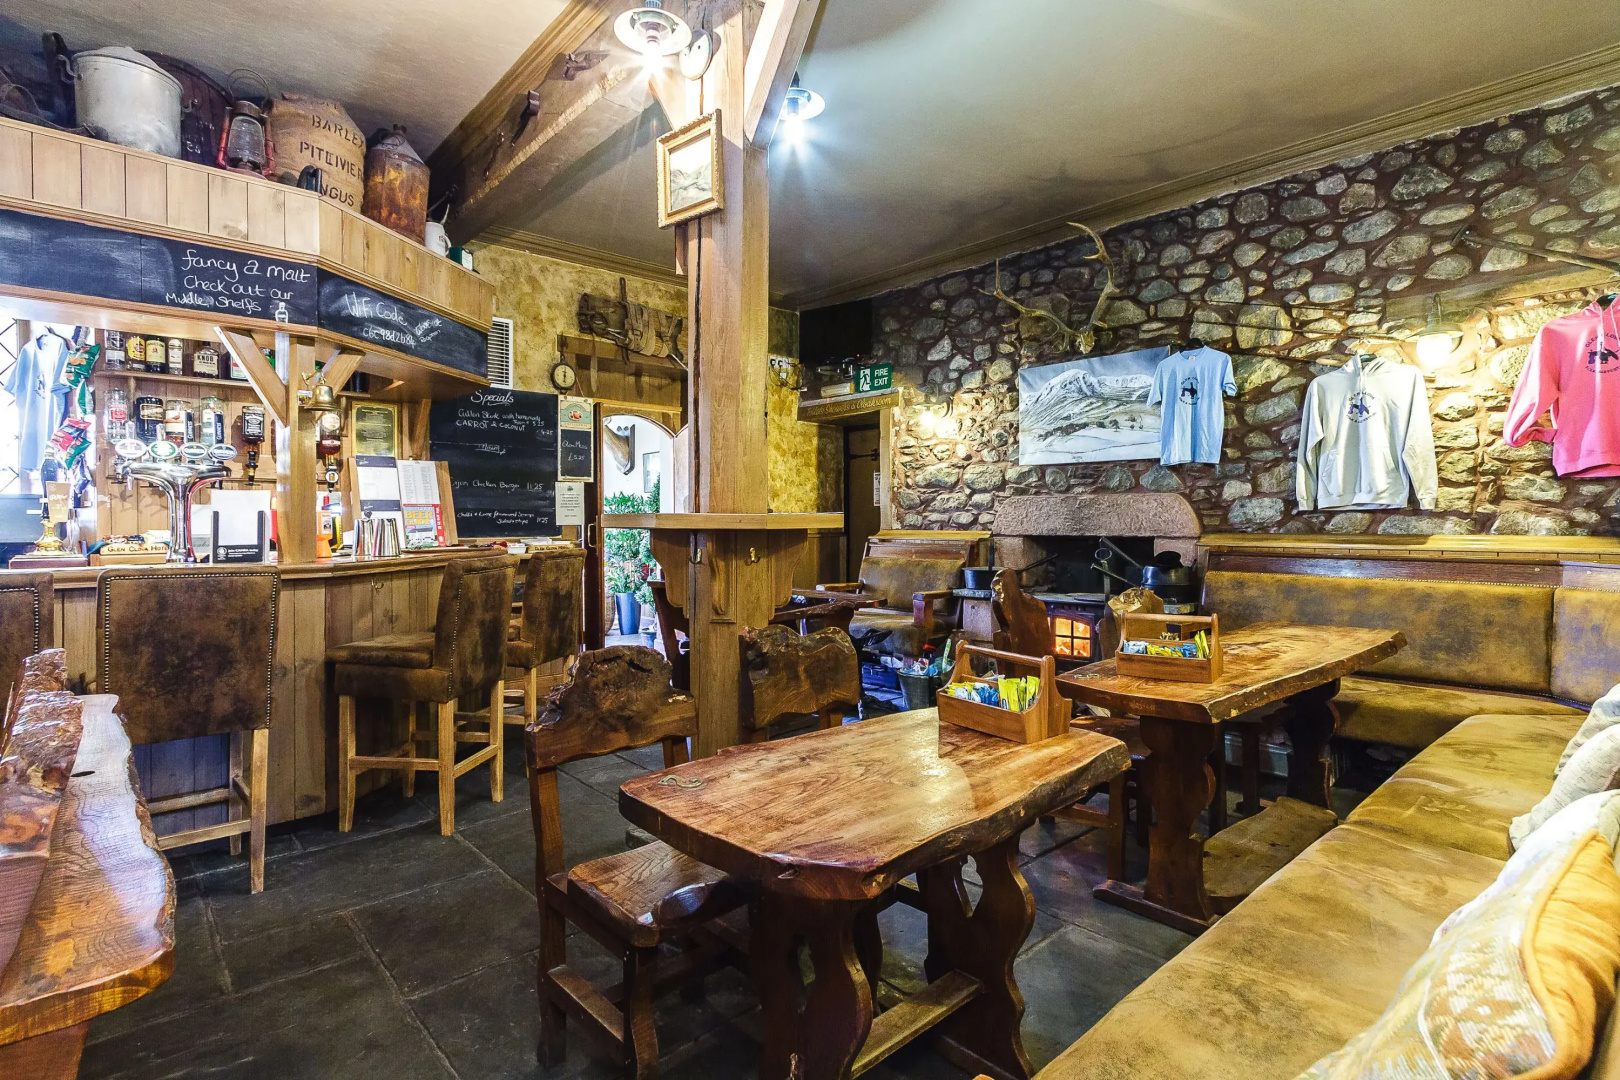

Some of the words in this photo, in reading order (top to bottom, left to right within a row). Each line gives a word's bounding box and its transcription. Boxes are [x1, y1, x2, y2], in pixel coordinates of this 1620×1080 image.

[321, 184, 355, 207] NGUS
[243, 260, 261, 275] a
[267, 265, 311, 283] malt
[184, 275, 229, 294] Check
[231, 283, 266, 297] out
[270, 288, 294, 300] our
[376, 302, 407, 326] Code
[197, 354, 214, 362] KNOB
[874, 367, 889, 377] FIRE
[874, 377, 889, 387] EXIT
[470, 390, 515, 406] Specials
[456, 419, 489, 429] CARROT
[500, 422, 526, 431] COCONUT
[472, 480, 497, 488] Chicken
[499, 481, 520, 492] Burger
[405, 510, 433, 519] BEER
